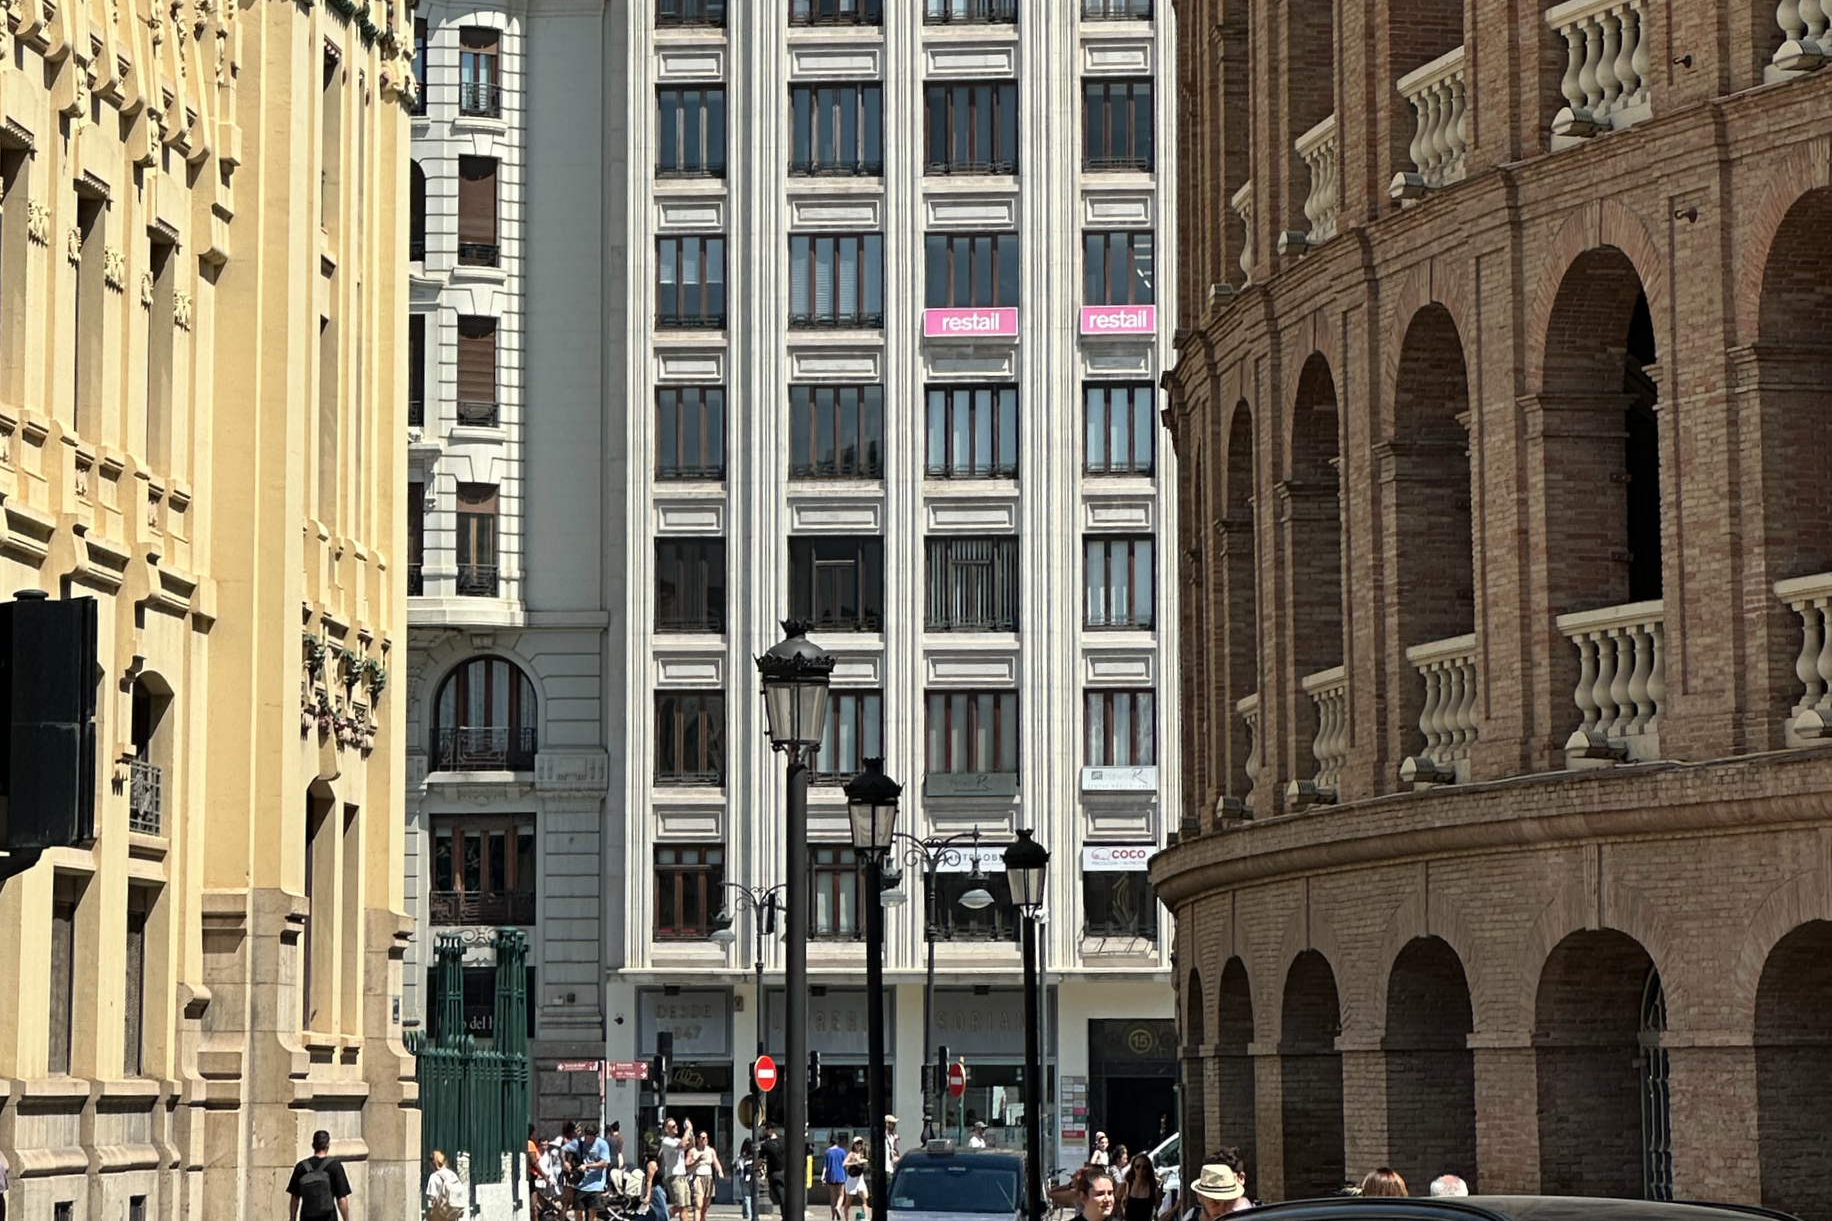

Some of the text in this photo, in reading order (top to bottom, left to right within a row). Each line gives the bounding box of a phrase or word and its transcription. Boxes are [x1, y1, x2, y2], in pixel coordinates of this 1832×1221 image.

[941, 312, 1000, 331] restail
[1089, 310, 1147, 328] restail
[1111, 849, 1147, 860] COCO
[656, 1004, 713, 1019] DESDE
[469, 1015, 486, 1030] del
[937, 1011, 1026, 1032] SORIAN
[1131, 1034, 1148, 1048] 15
